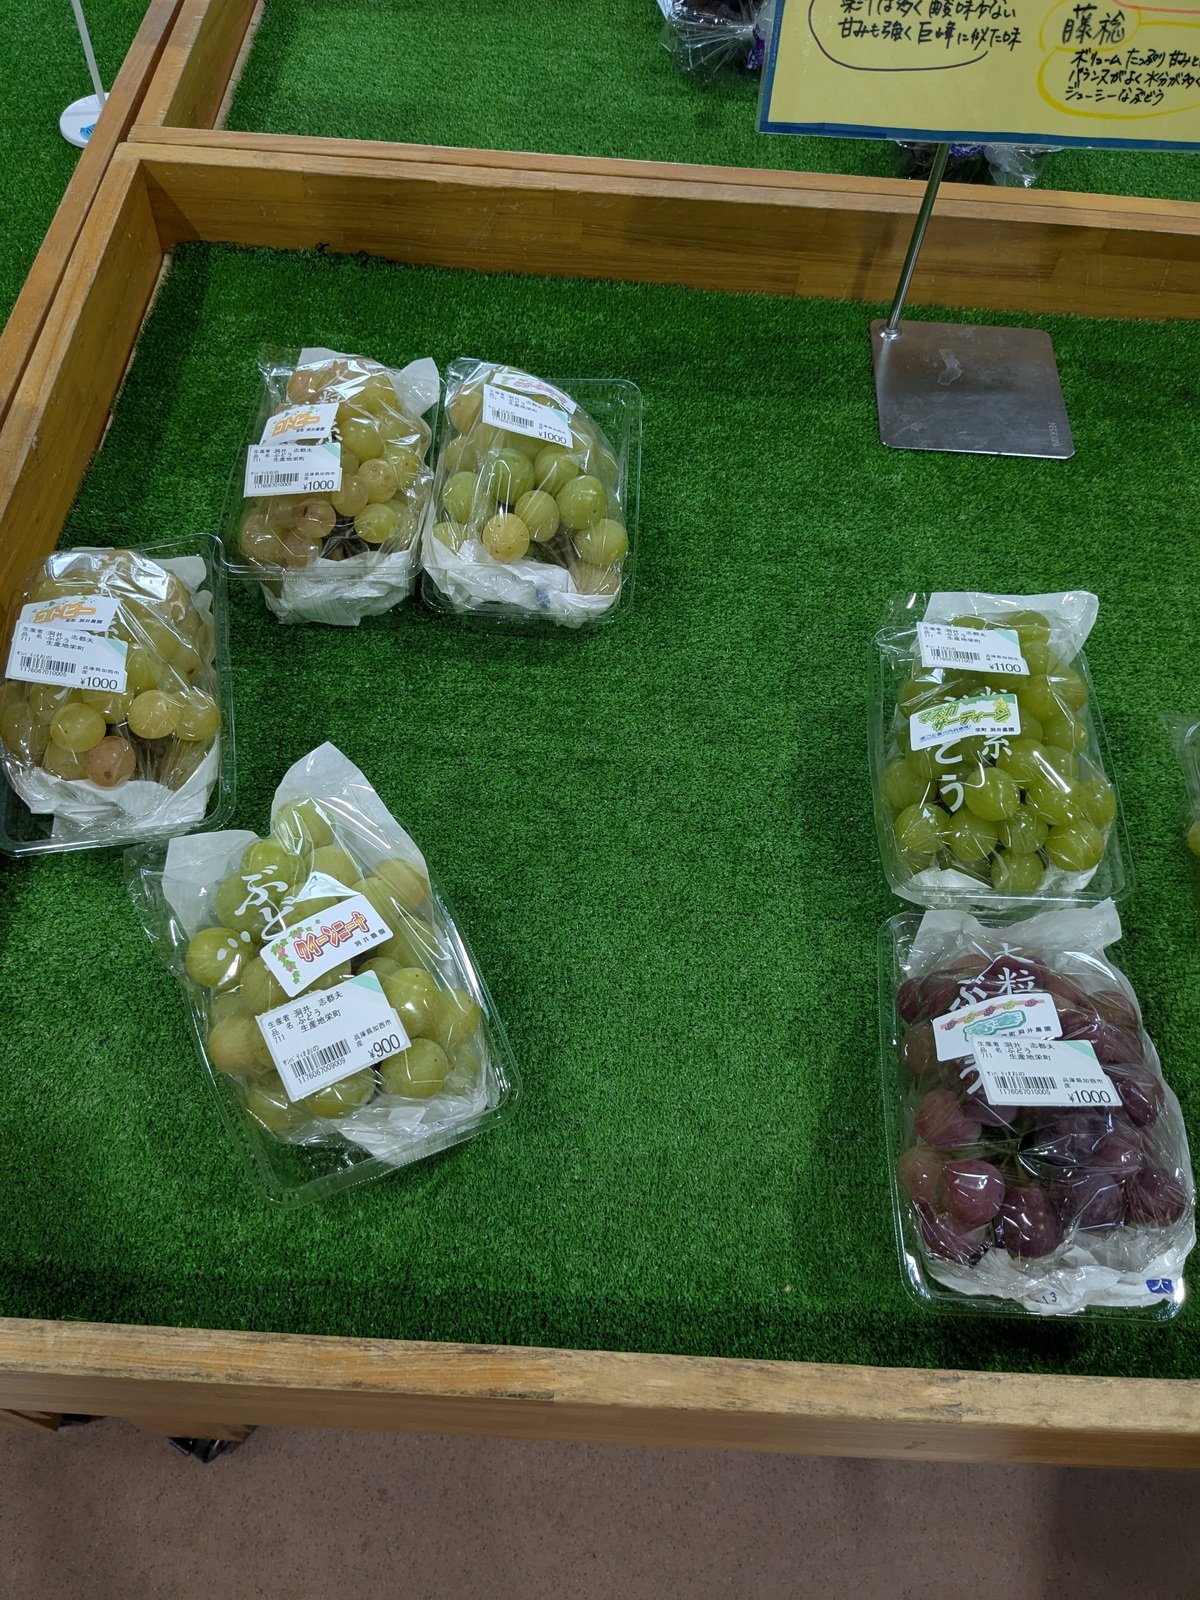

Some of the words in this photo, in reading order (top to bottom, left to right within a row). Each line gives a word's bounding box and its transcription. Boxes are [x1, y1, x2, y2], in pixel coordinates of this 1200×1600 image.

[539, 431, 567, 444] ¥1000
[303, 480, 335, 491] ¥1000
[990, 662, 1022, 673] ¥1100
[80, 676, 118, 690] ¥1000
[368, 1034, 401, 1060] ¥900
[297, 1057, 346, 1084] 1176067009009
[1068, 1090, 1112, 1103] ¥1000
